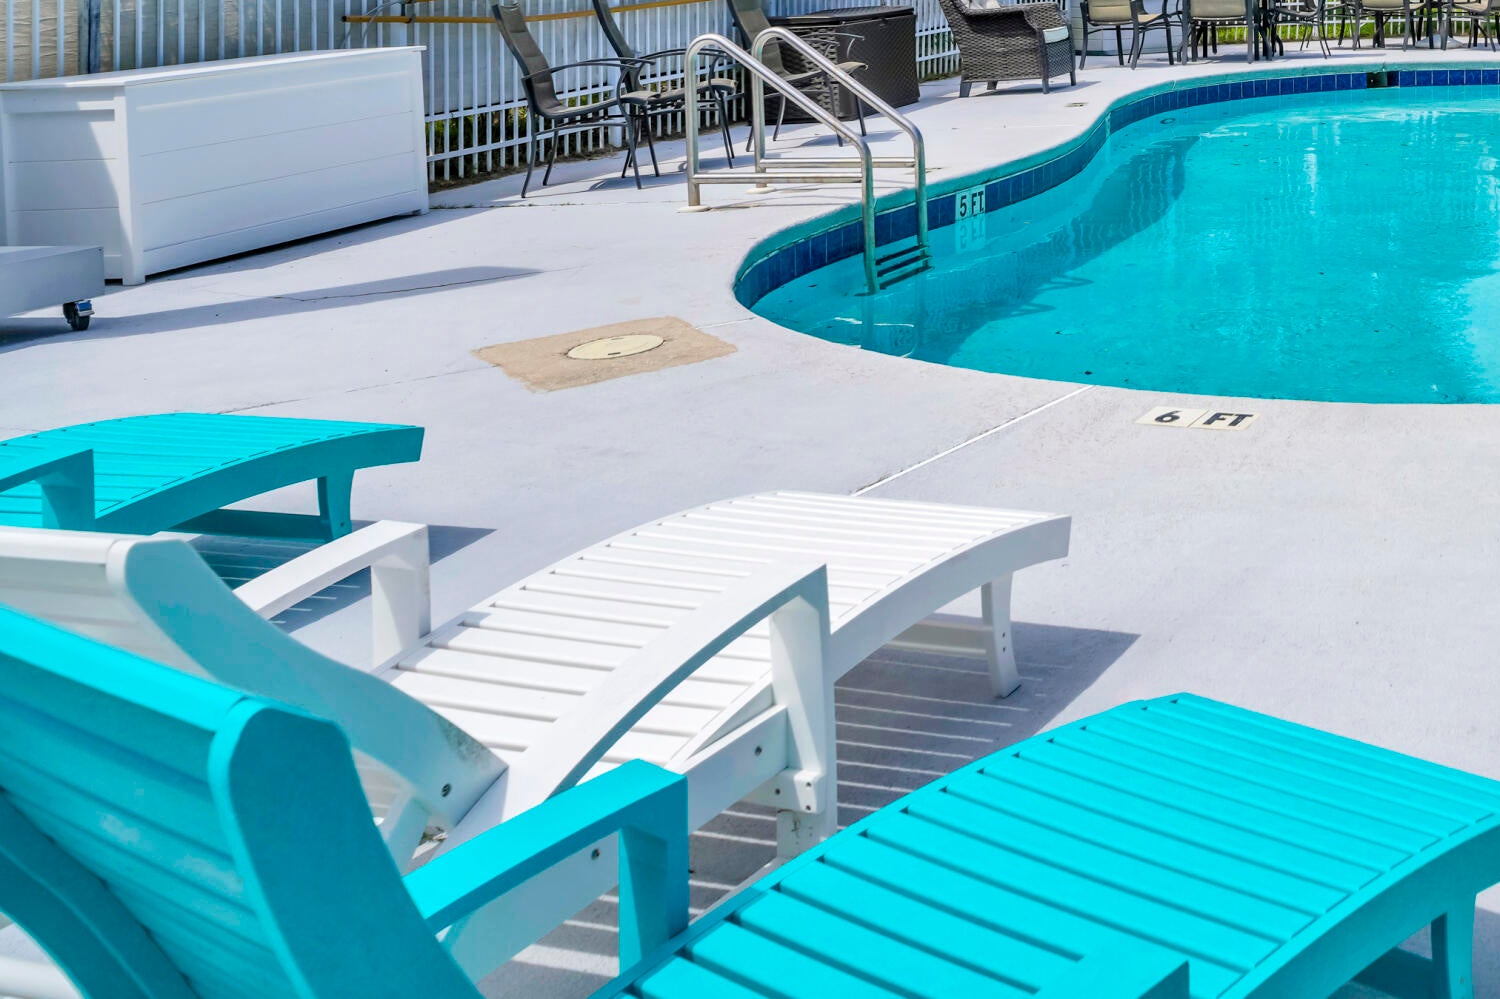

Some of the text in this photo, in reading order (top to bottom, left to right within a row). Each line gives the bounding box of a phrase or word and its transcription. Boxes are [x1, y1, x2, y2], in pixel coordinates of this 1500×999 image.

[960, 194, 967, 217] 5
[1154, 410, 1254, 426] 6 FT
